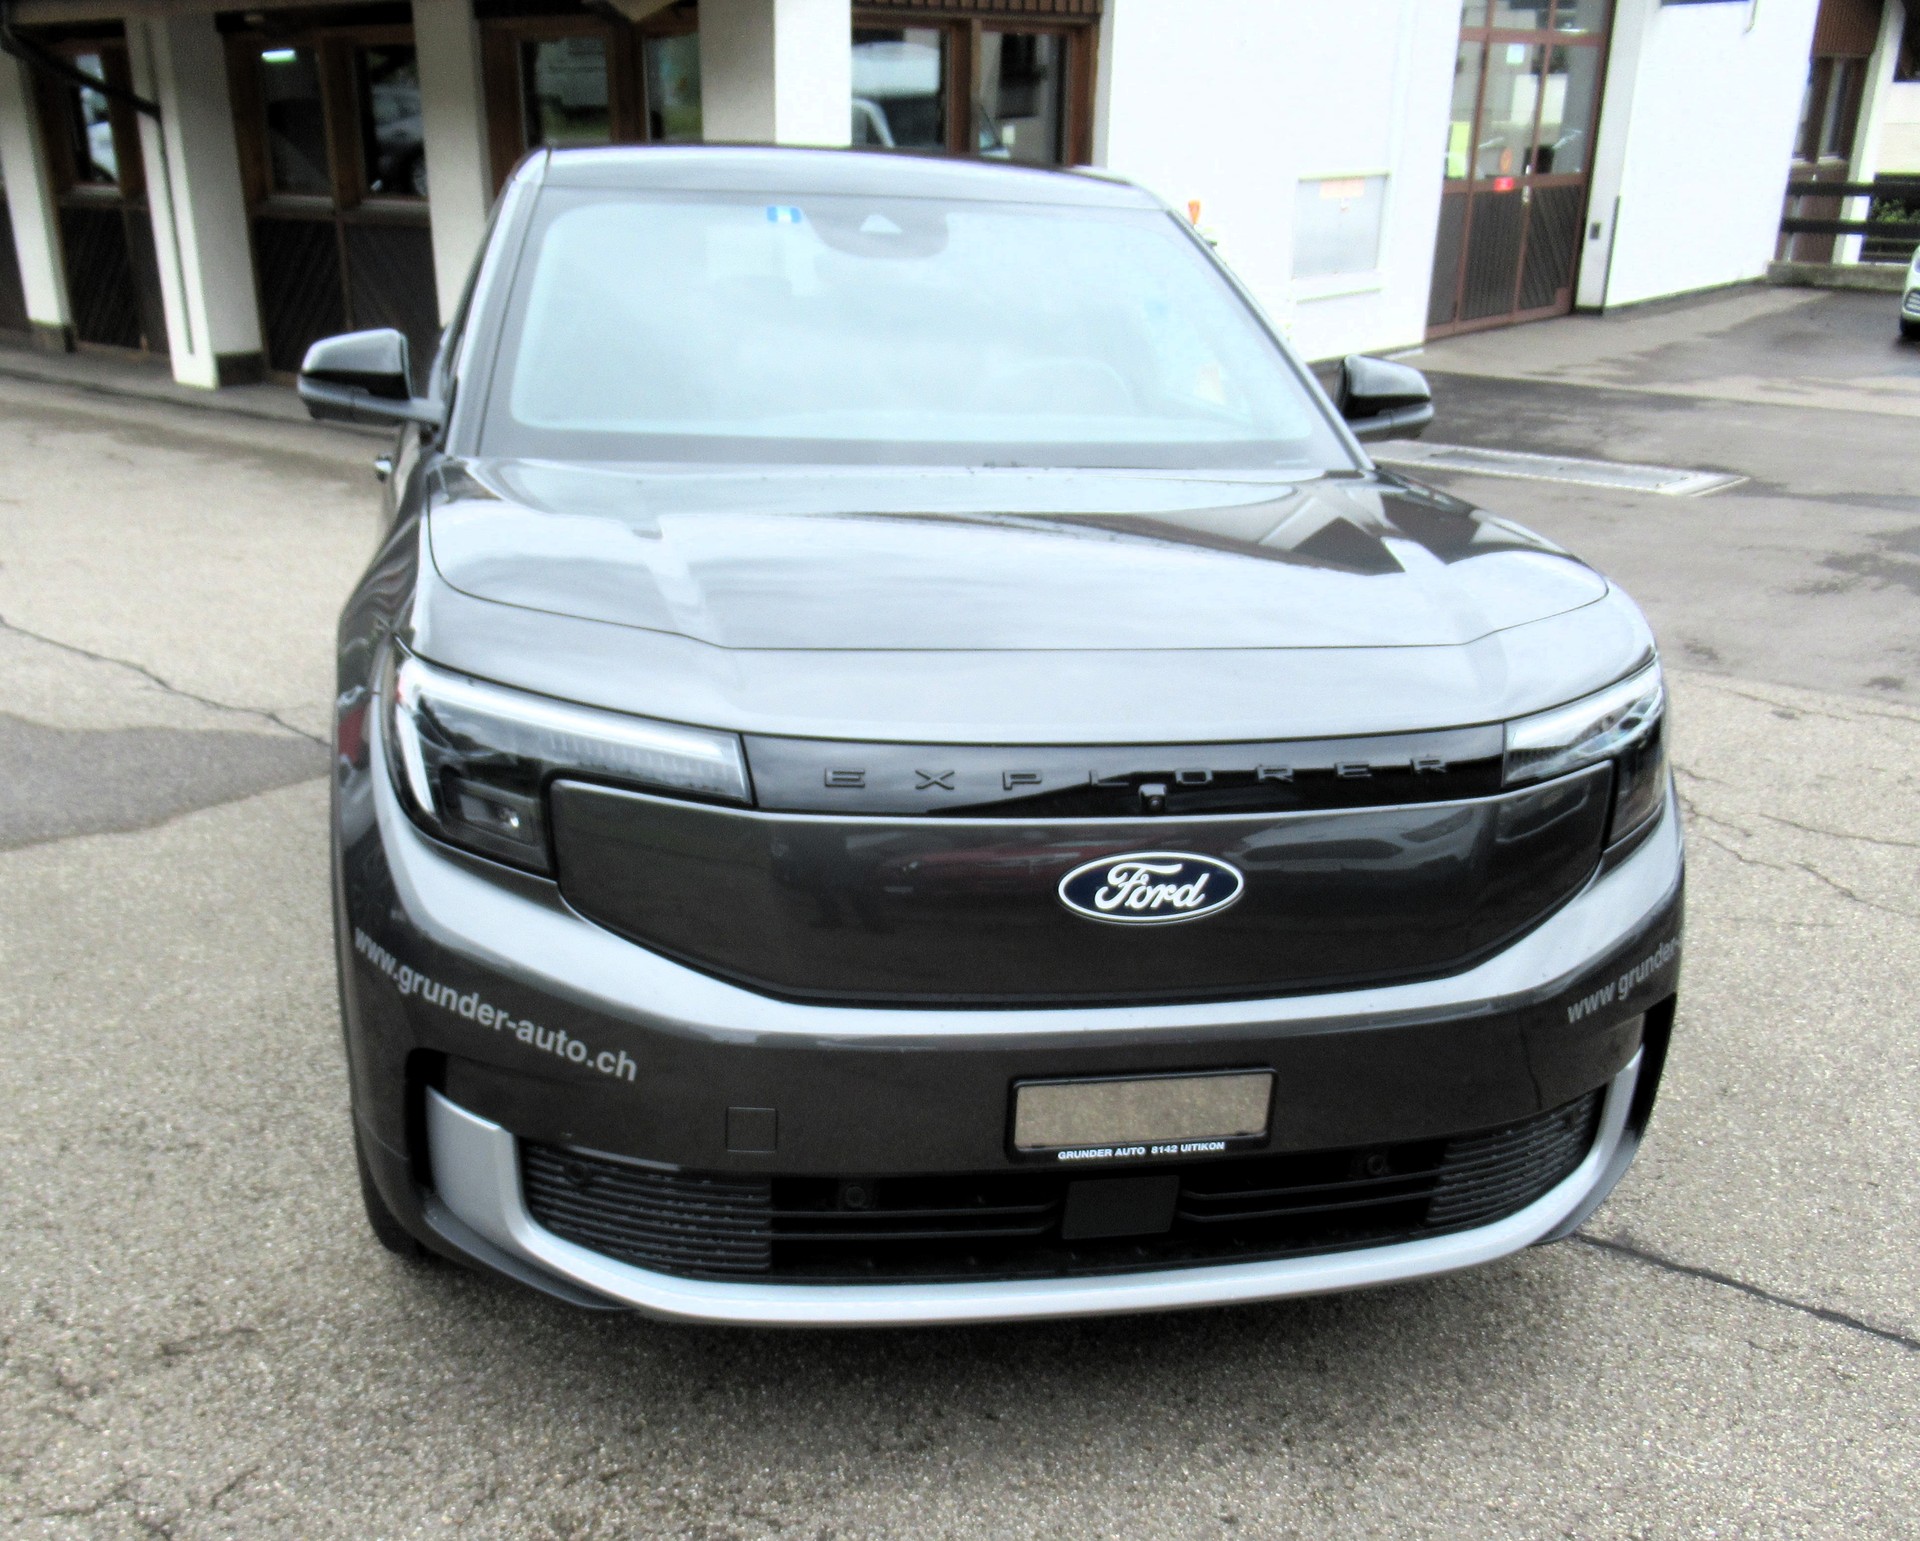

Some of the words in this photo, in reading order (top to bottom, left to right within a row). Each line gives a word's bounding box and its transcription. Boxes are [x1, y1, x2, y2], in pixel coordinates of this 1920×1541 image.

[825, 755, 1447, 791] EXPLORER
[1094, 862, 1210, 910] Ford
[355, 927, 637, 1082] www.grunder-auto.ch
[1058, 1148, 1113, 1160] GRUNDER
[1114, 1147, 1146, 1157] AUTO
[1151, 1145, 1178, 1154] 8142
[1180, 1142, 1225, 1152] UITIKON
